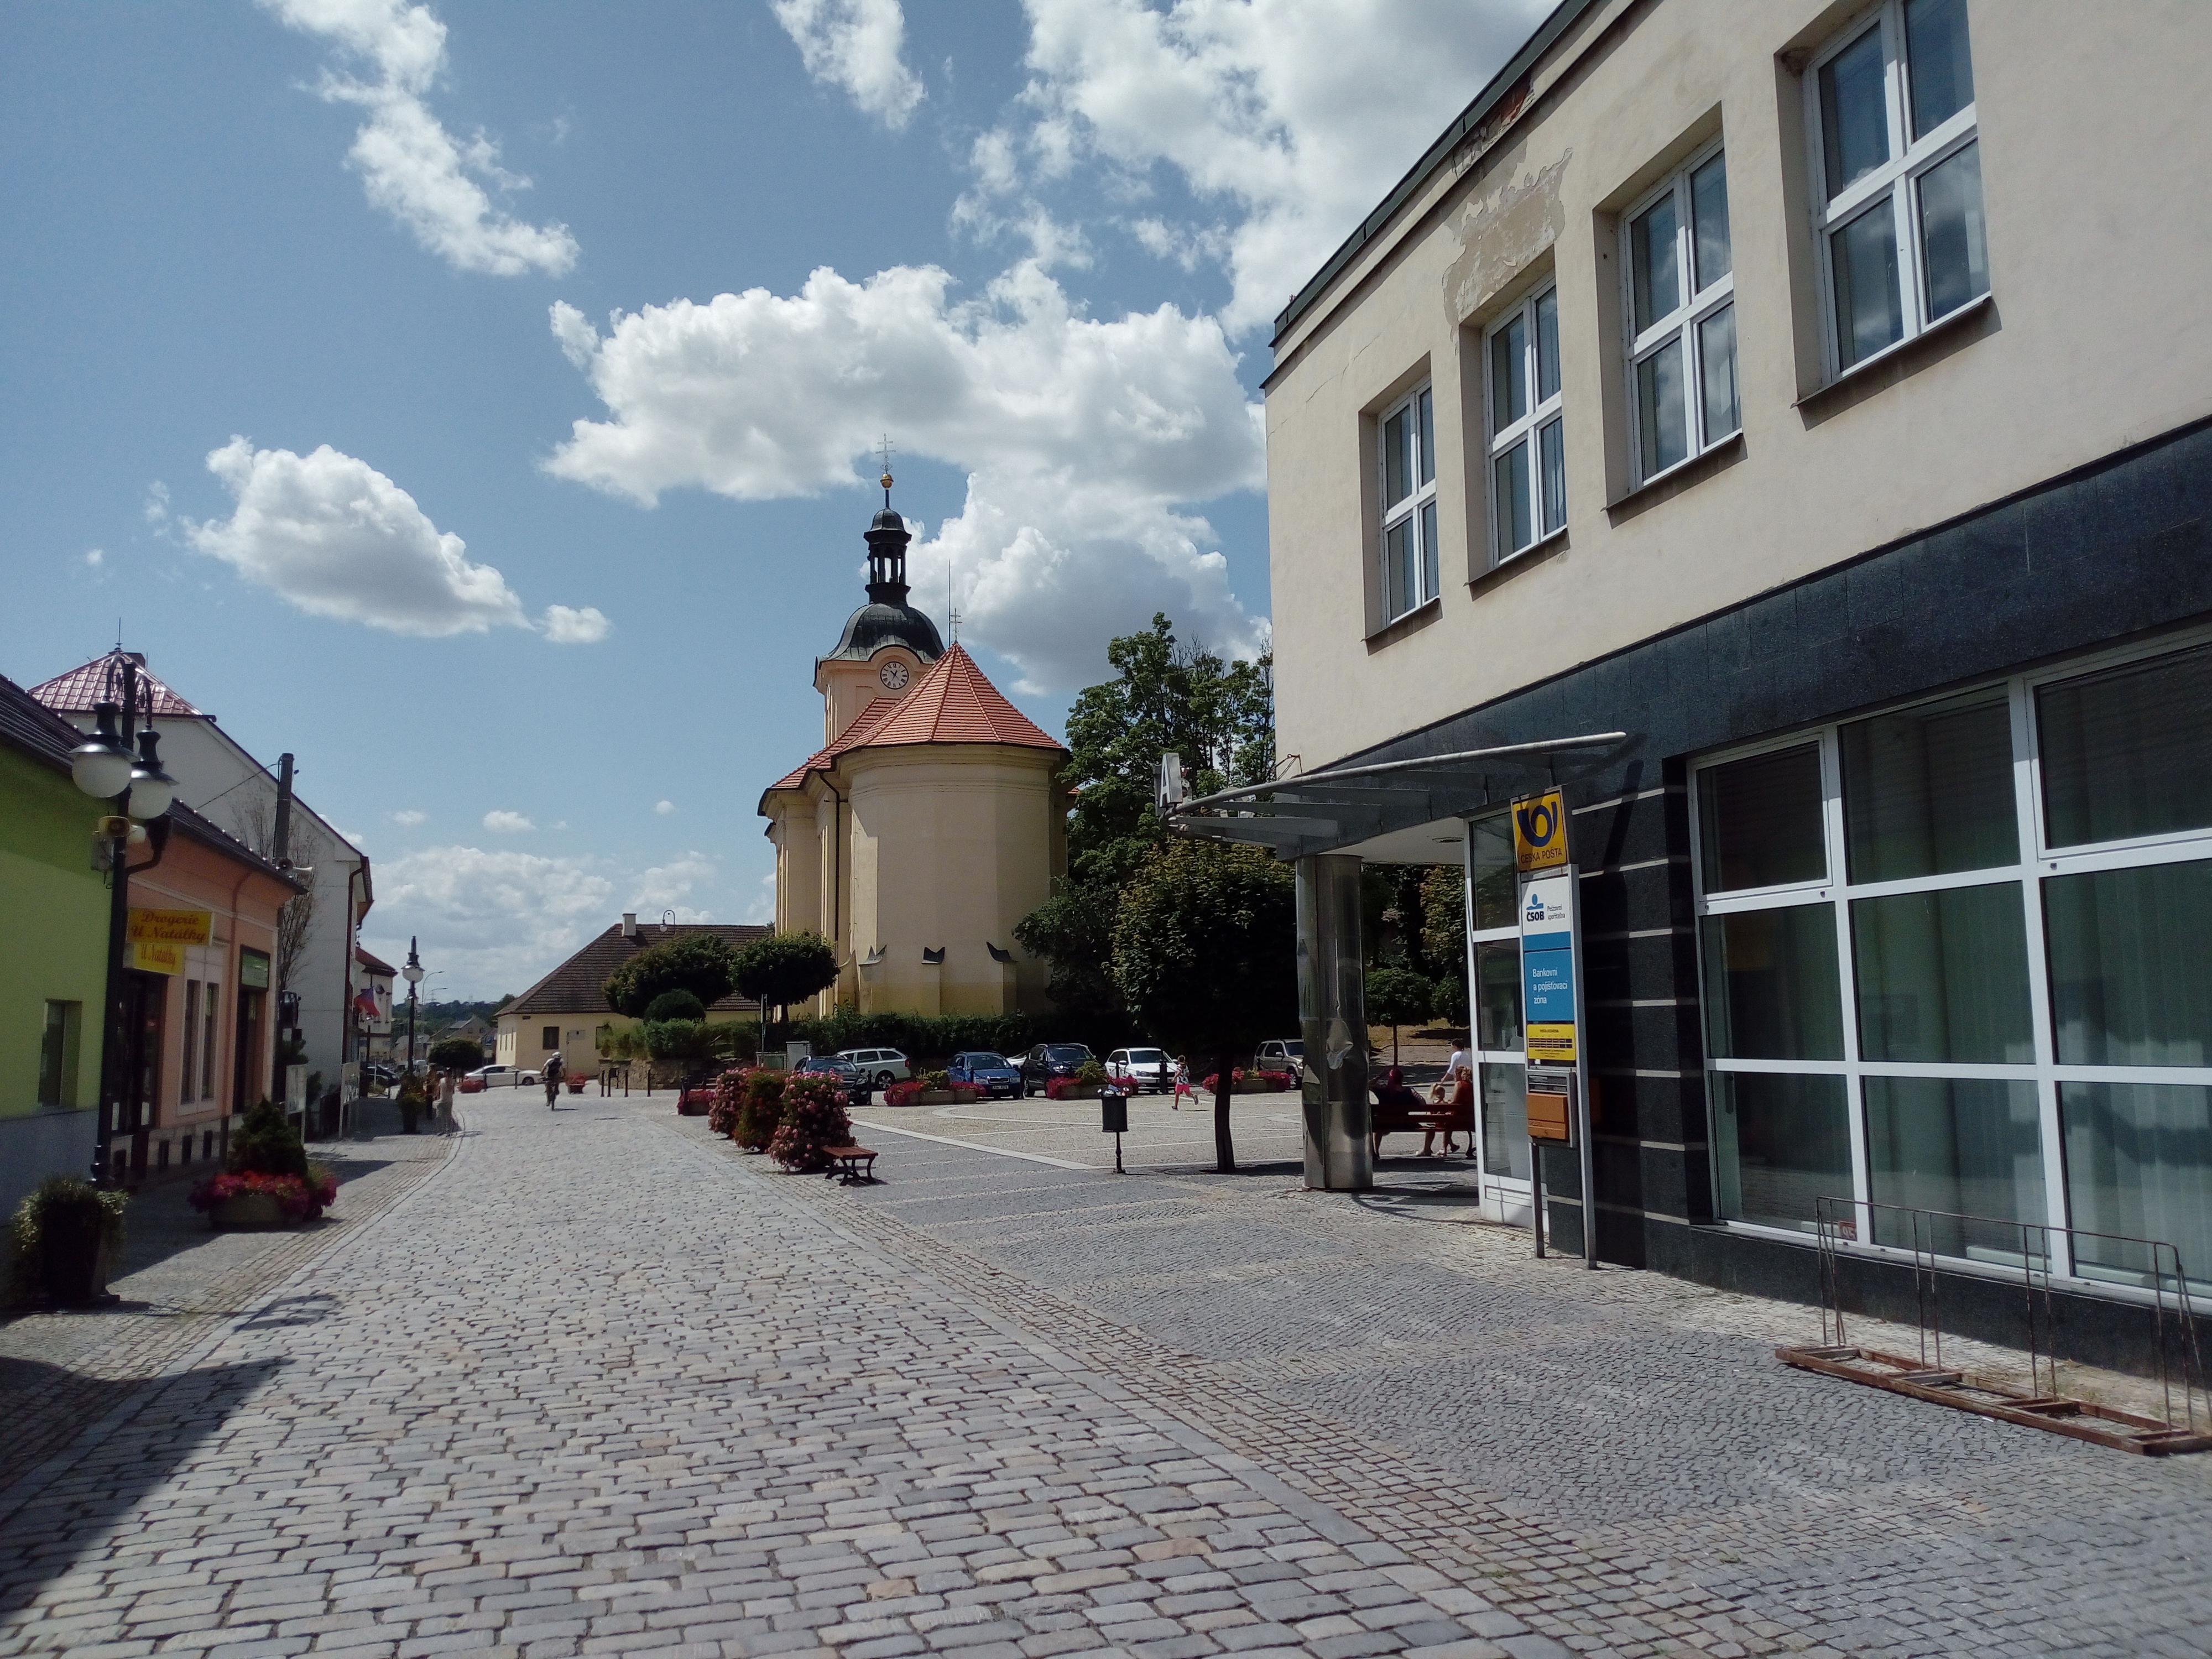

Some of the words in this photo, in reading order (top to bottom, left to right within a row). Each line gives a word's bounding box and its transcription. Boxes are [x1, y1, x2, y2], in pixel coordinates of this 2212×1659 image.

[1542, 847, 1562, 859] POŠTA
[141, 912, 199, 926] Drogerie
[1526, 911, 1545, 922] ČSOB
[132, 925, 144, 937] U
[141, 943, 147, 960] U
[1532, 967, 1558, 977] Bankovní
[1538, 980, 1568, 992] pojišťovací
[1533, 995, 1547, 1004] zóna
